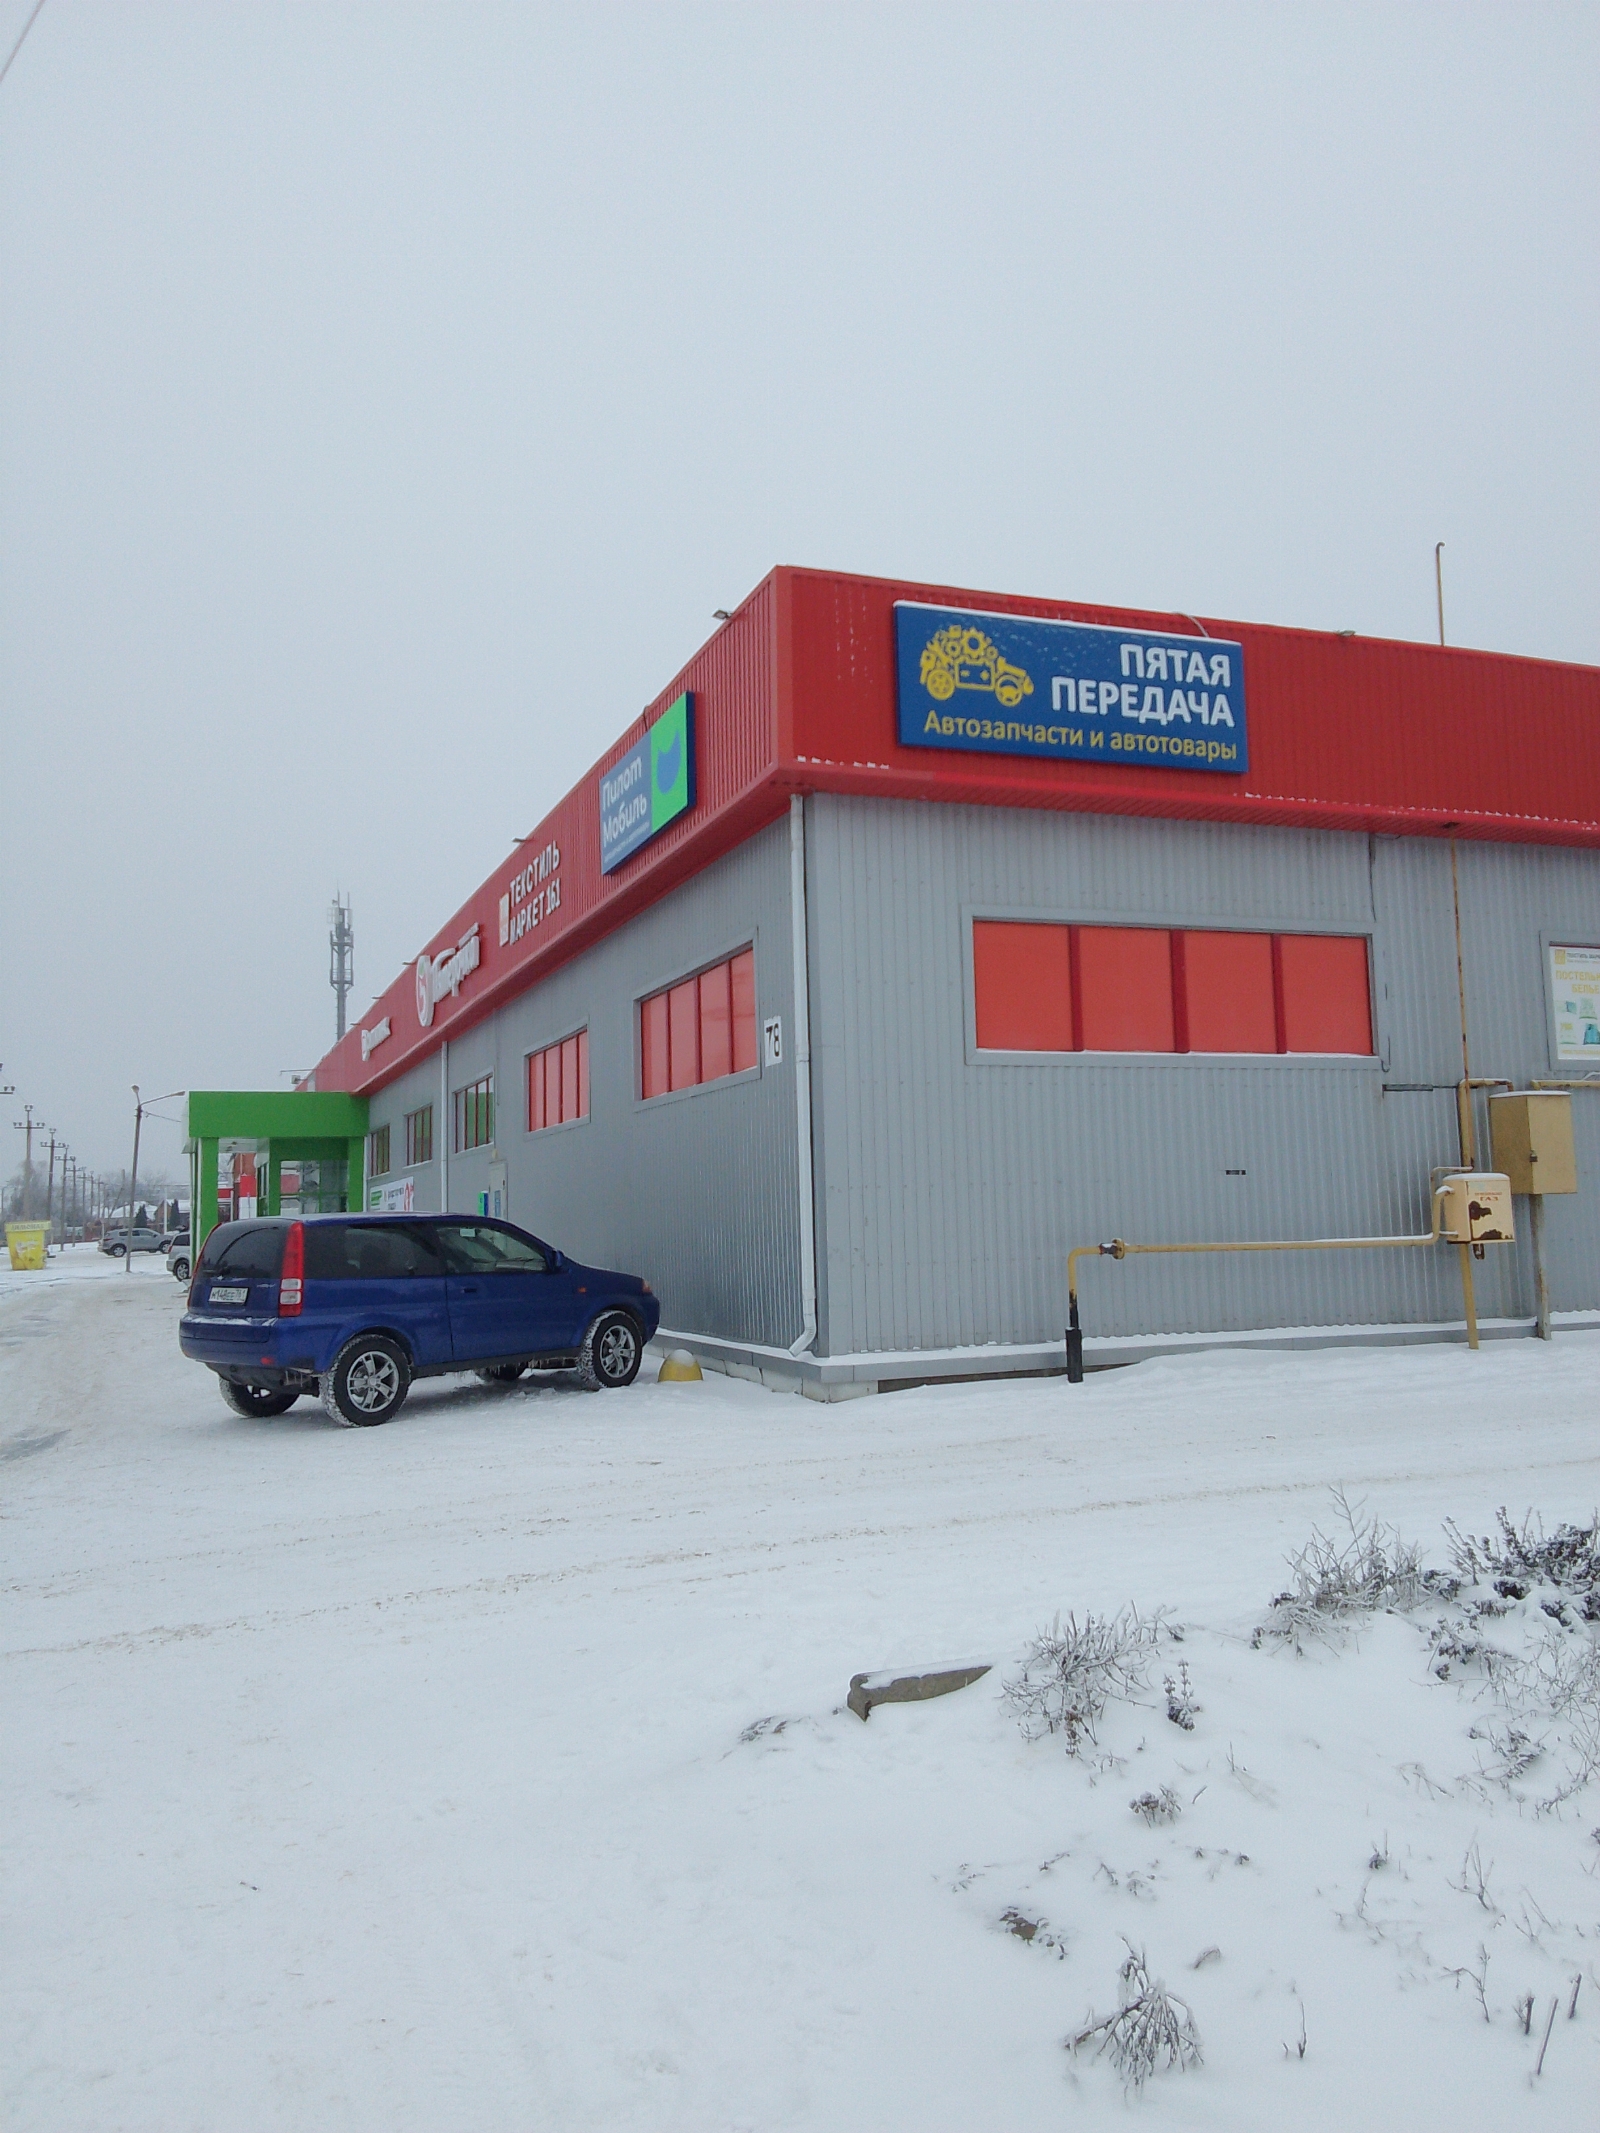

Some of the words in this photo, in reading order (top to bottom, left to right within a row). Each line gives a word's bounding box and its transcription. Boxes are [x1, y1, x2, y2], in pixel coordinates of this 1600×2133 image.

[1119, 643, 1231, 687] ПЯТАЯ
[1051, 676, 1235, 727] ПЕРЕДАЧА
[924, 710, 1083, 747] Автозапчасти
[1090, 731, 1104, 747] и
[1110, 732, 1237, 763] автотовары
[602, 756, 643, 811] Пилот
[603, 793, 647, 847] Мобиль
[510, 840, 560, 908] ТЕКСТИЛЬ
[510, 890, 545, 946] МАРКЕТ
[546, 877, 561, 915] 161
